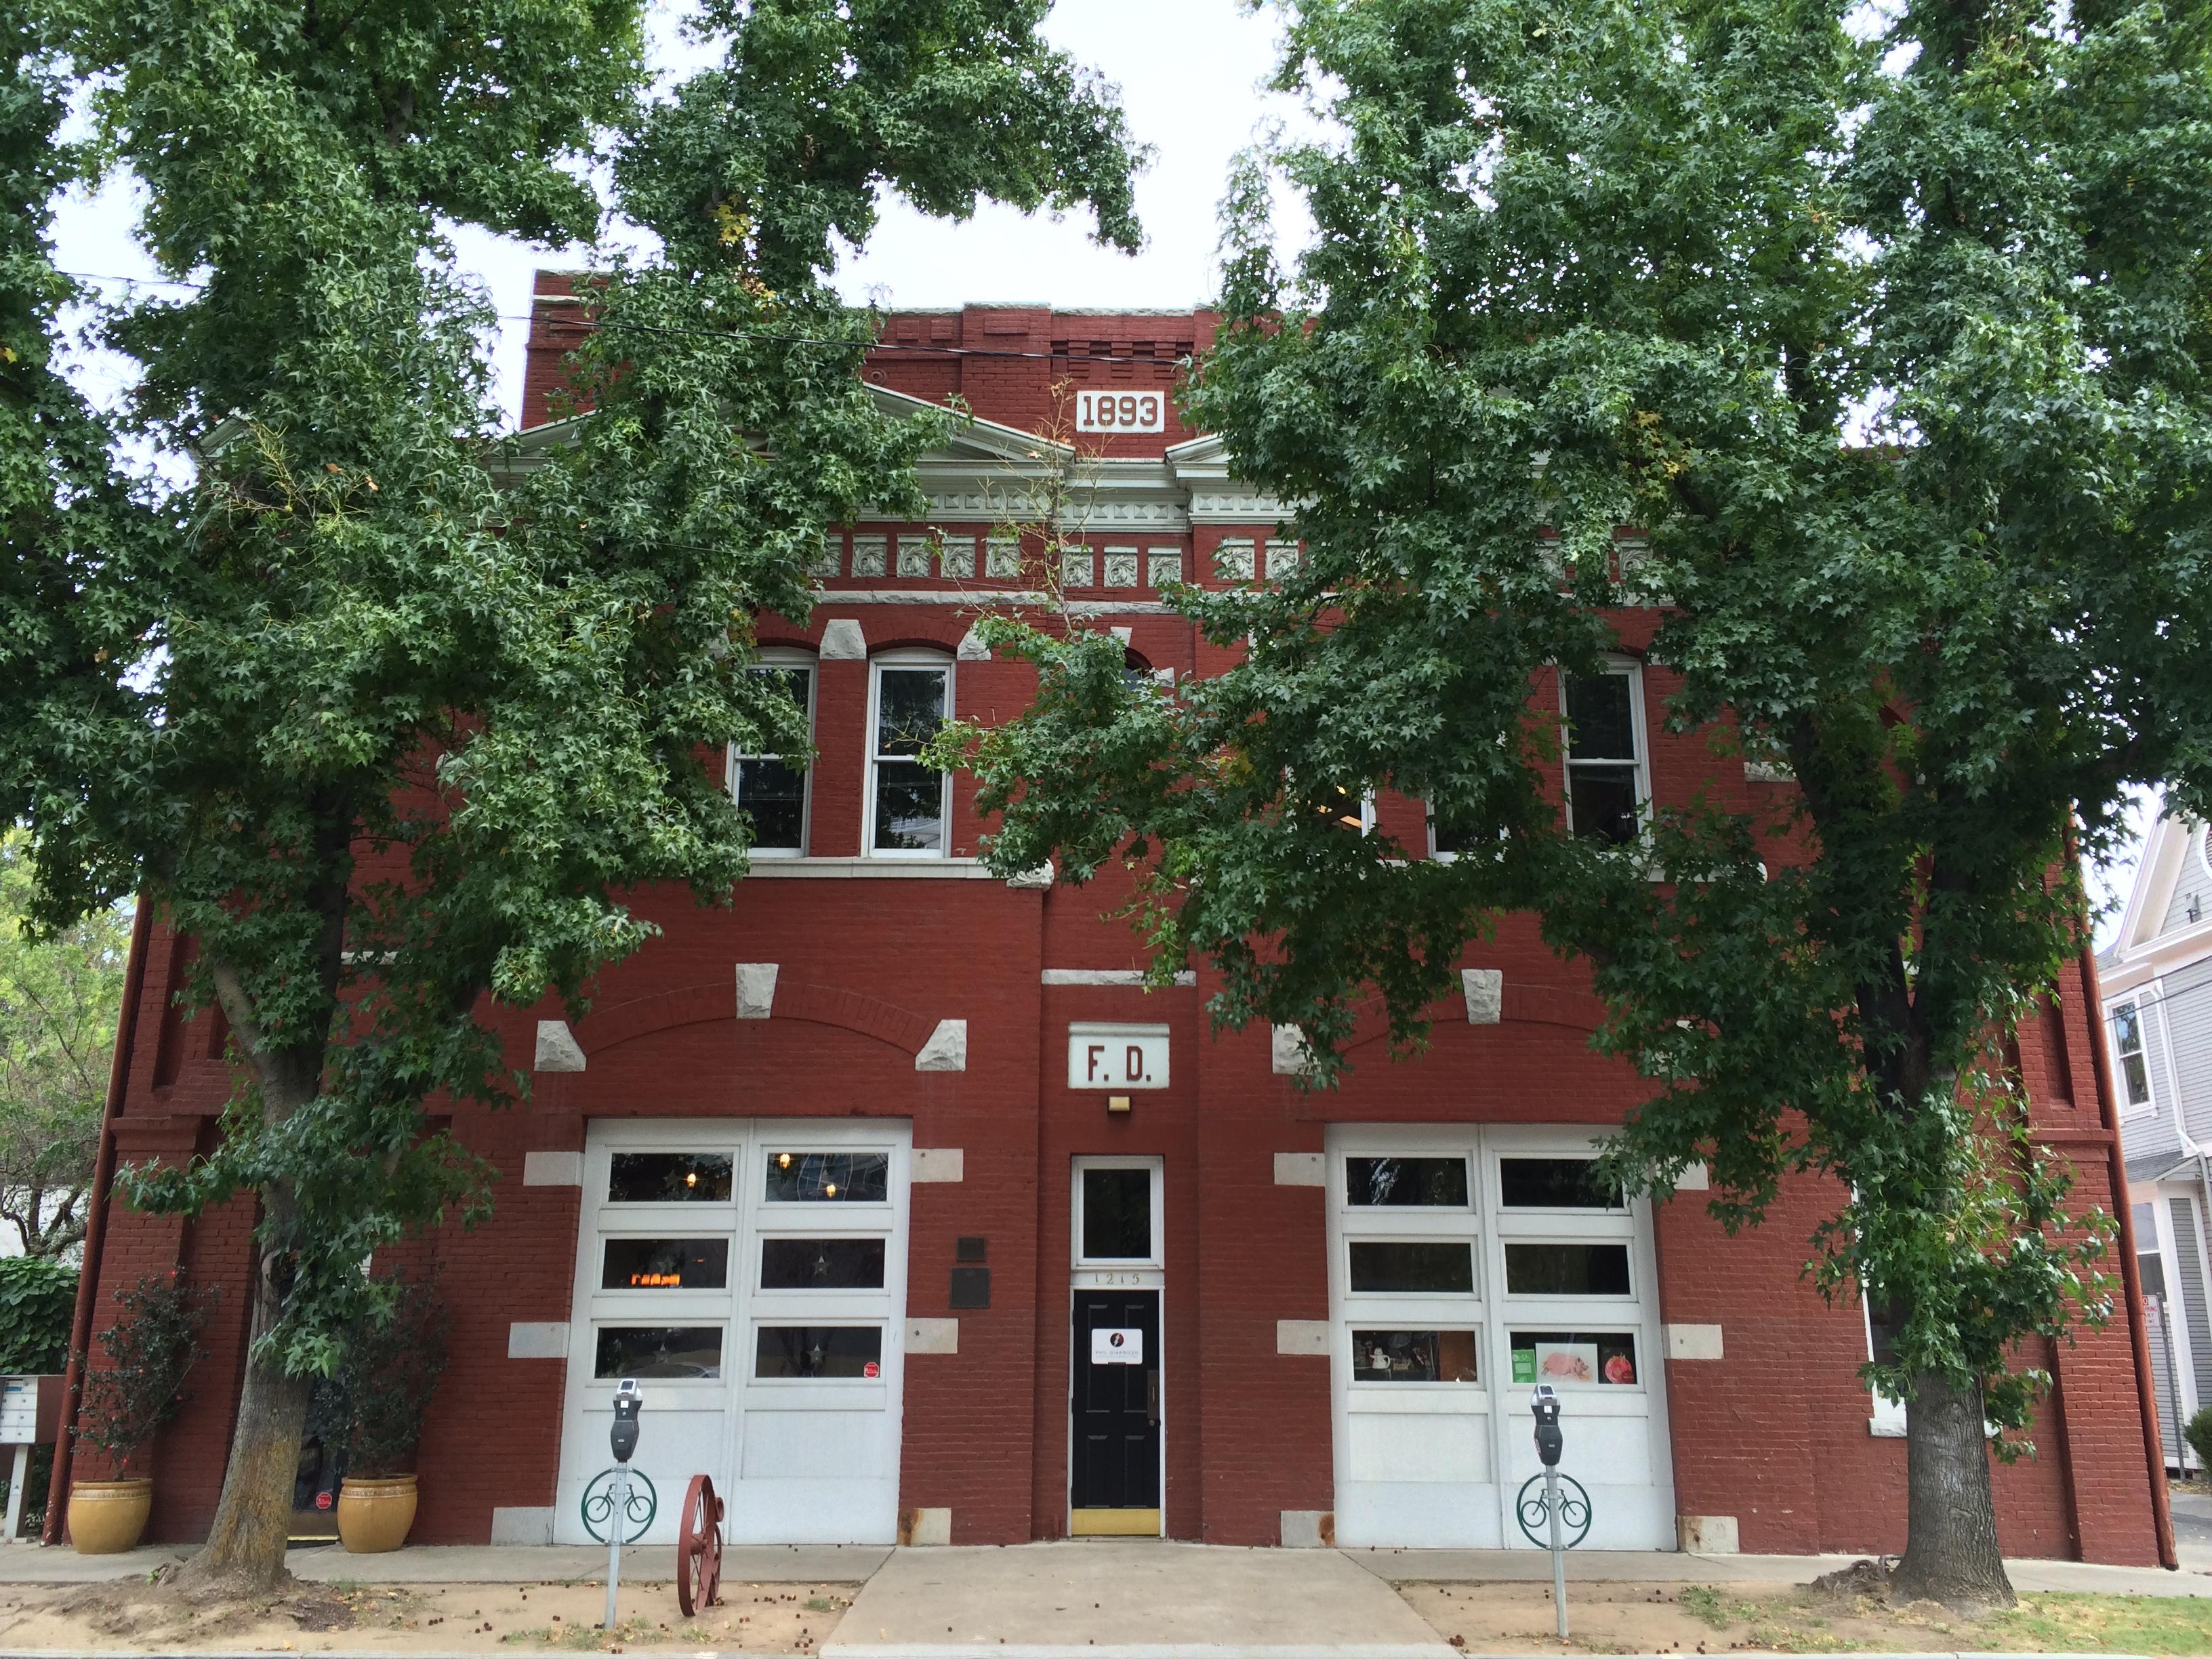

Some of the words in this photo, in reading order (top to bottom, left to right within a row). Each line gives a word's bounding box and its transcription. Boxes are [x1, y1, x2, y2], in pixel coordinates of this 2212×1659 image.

[1083, 395, 1158, 426] 1893
[1088, 1045, 1109, 1082] F.
[1126, 1045, 1151, 1082] D.
[1094, 1273, 1140, 1285] 1215
[2142, 1296, 2149, 1306] O
